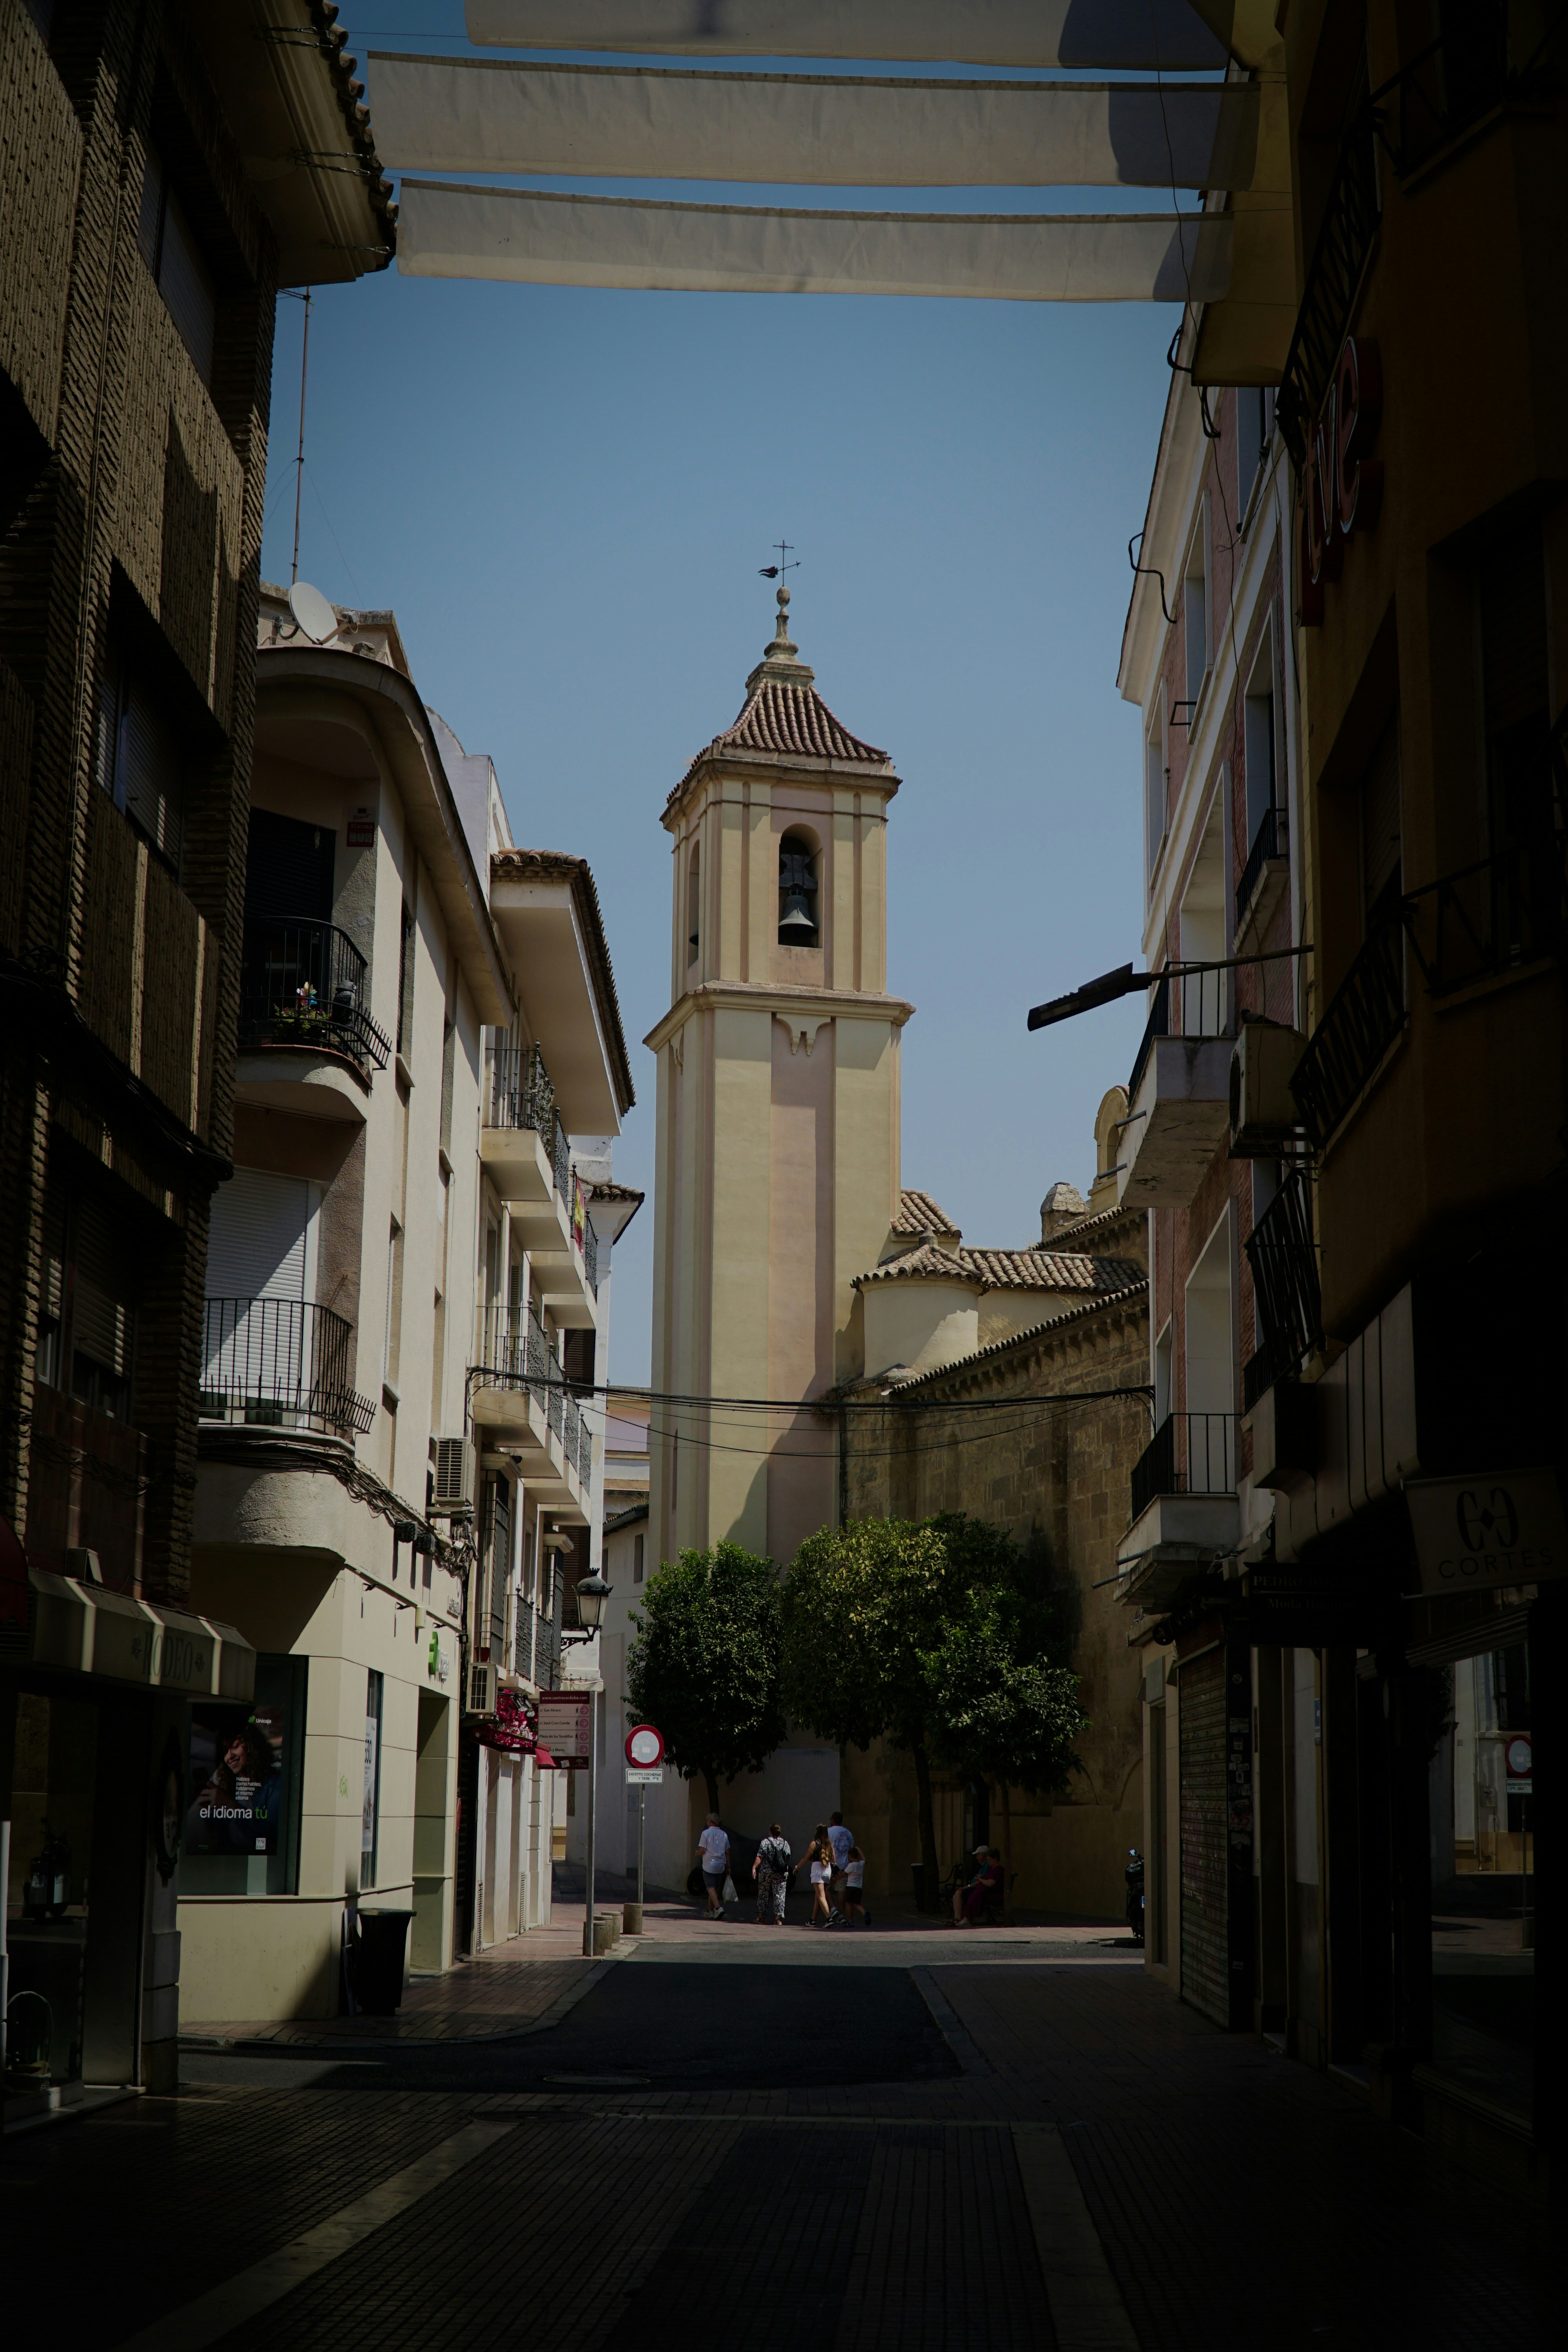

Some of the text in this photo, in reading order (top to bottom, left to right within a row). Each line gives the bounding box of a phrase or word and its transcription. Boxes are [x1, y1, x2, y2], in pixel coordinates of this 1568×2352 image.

[1439, 1548, 1553, 1578] CORTES
[1253, 1575, 1302, 1587] PEDRO
[1267, 1598, 1301, 1609] Moda
[142, 1632, 193, 1682] RODEO
[200, 1805, 268, 1819] el idioma tú
